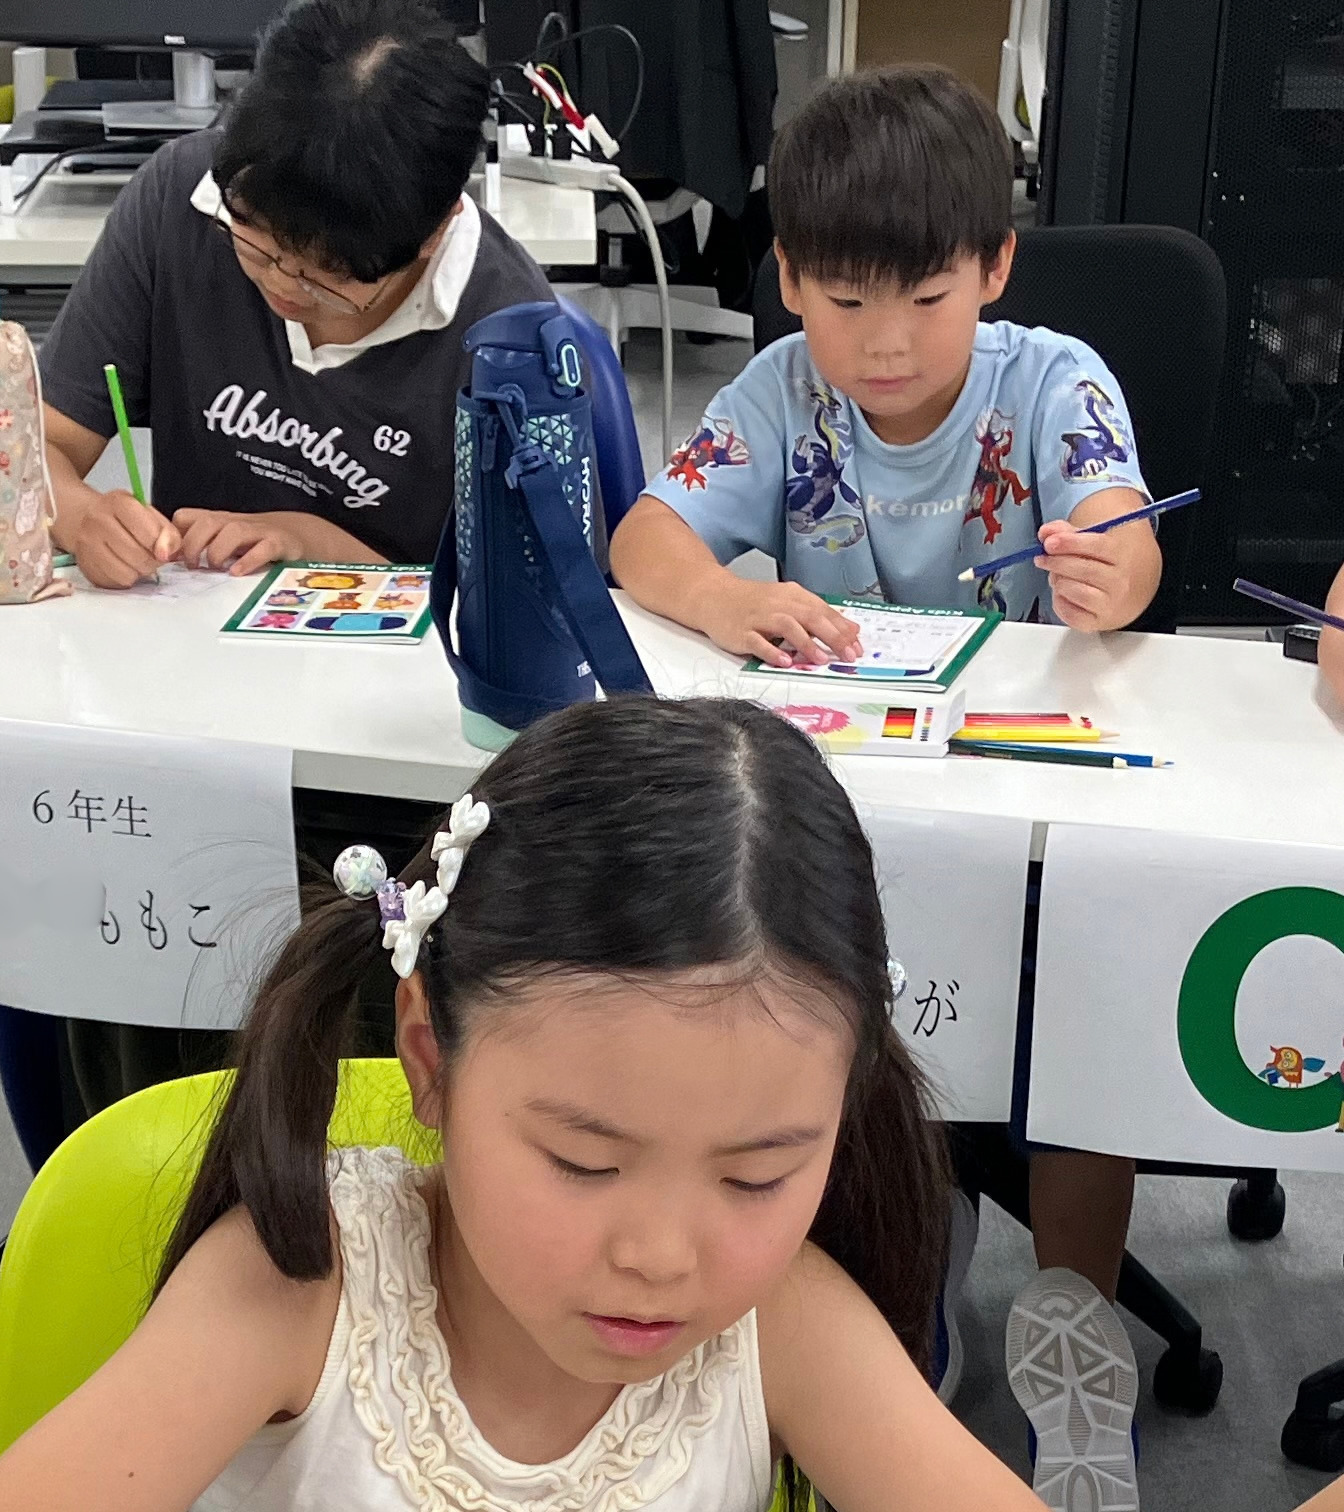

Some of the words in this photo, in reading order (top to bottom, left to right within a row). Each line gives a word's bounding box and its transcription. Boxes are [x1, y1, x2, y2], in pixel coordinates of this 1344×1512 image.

[203, 384, 390, 509] Absorbing
[373, 424, 412, 457] 62
[842, 600, 925, 615] Approach
[32, 789, 153, 838] 6年生
